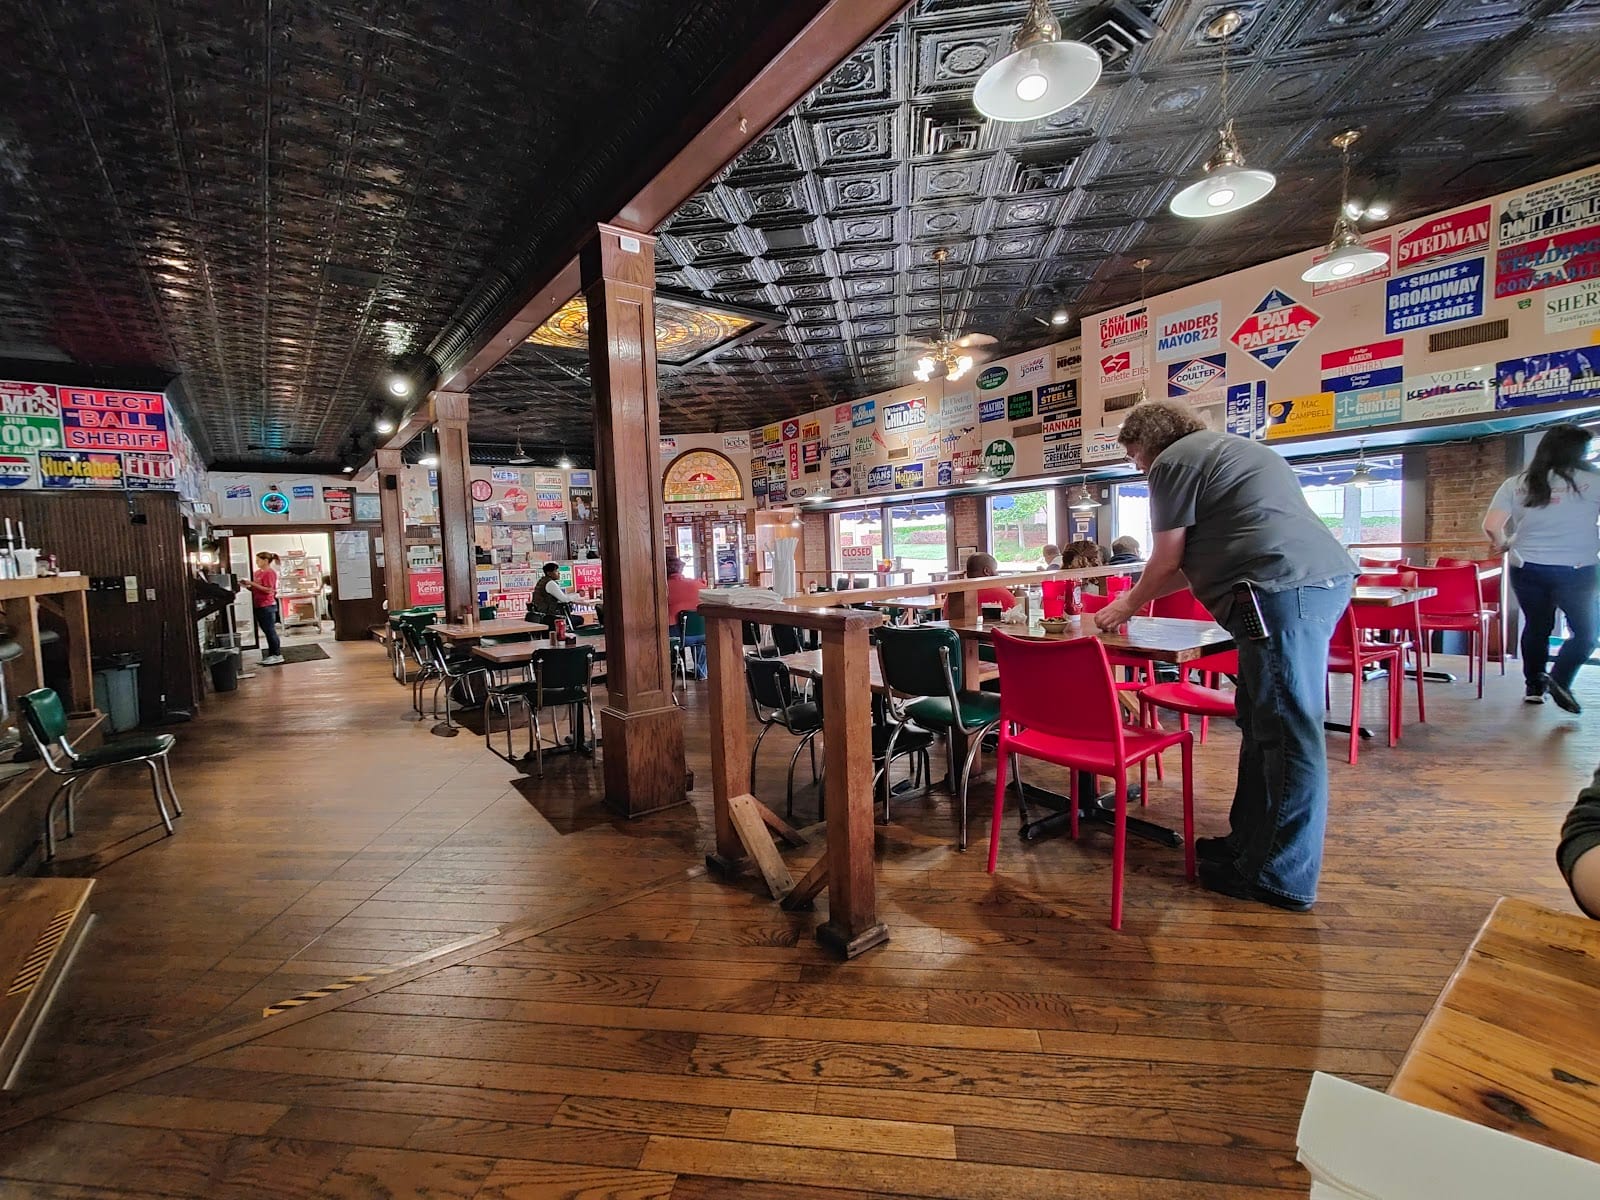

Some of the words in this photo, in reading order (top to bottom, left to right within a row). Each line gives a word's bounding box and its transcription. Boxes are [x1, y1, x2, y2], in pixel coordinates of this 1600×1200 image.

[1501, 212, 1546, 239] EMMITT
[1399, 221, 1489, 261] STEDMAN
[1409, 267, 1458, 288] SHANE
[1497, 261, 1600, 295] CONSTABLE
[1389, 275, 1480, 310] BROADWAY
[1547, 291, 1600, 316] SHER
[1109, 314, 1125, 325] KEN
[1164, 312, 1219, 337] LANDERS
[1258, 309, 1294, 330] PAT
[1393, 313, 1428, 330] STATE
[1429, 303, 1475, 322] SENATE
[1101, 315, 1148, 341] COWLING
[1239, 320, 1313, 349] PAPPAS
[1158, 331, 1201, 351] MAYOR
[1202, 326, 1218, 341] 22
[1177, 369, 1216, 382] COULTER
[1431, 369, 1474, 384] VOTE
[1048, 384, 1066, 393] TRACY
[71, 393, 155, 410] ELECT
[1041, 390, 1073, 405] STEELE
[1302, 400, 1319, 409] MAC
[984, 401, 1004, 414] MATHIS
[1237, 392, 1251, 435] PRIEST
[1290, 410, 1333, 421] CAMPBELL
[78, 409, 157, 431] BALL
[884, 407, 926, 430] CHILDERS
[1042, 418, 1081, 434] HANNAH
[72, 431, 162, 447] SHERIFF
[855, 442, 873, 452] KELLY
[993, 442, 1007, 453] Pat
[1056, 443, 1071, 452] MIKE
[1087, 445, 1099, 453] VIC
[790, 443, 799, 479] HOPE
[1045, 450, 1081, 463] CREEKMORE
[41, 455, 121, 479] Huckabee
[868, 469, 892, 481] EVANS
[571, 488, 593, 497] Hillary
[192, 502, 212, 513] MEN
[842, 547, 872, 557] CLOSED
[577, 568, 597, 576] Mary
[418, 585, 445, 594] Kemp
